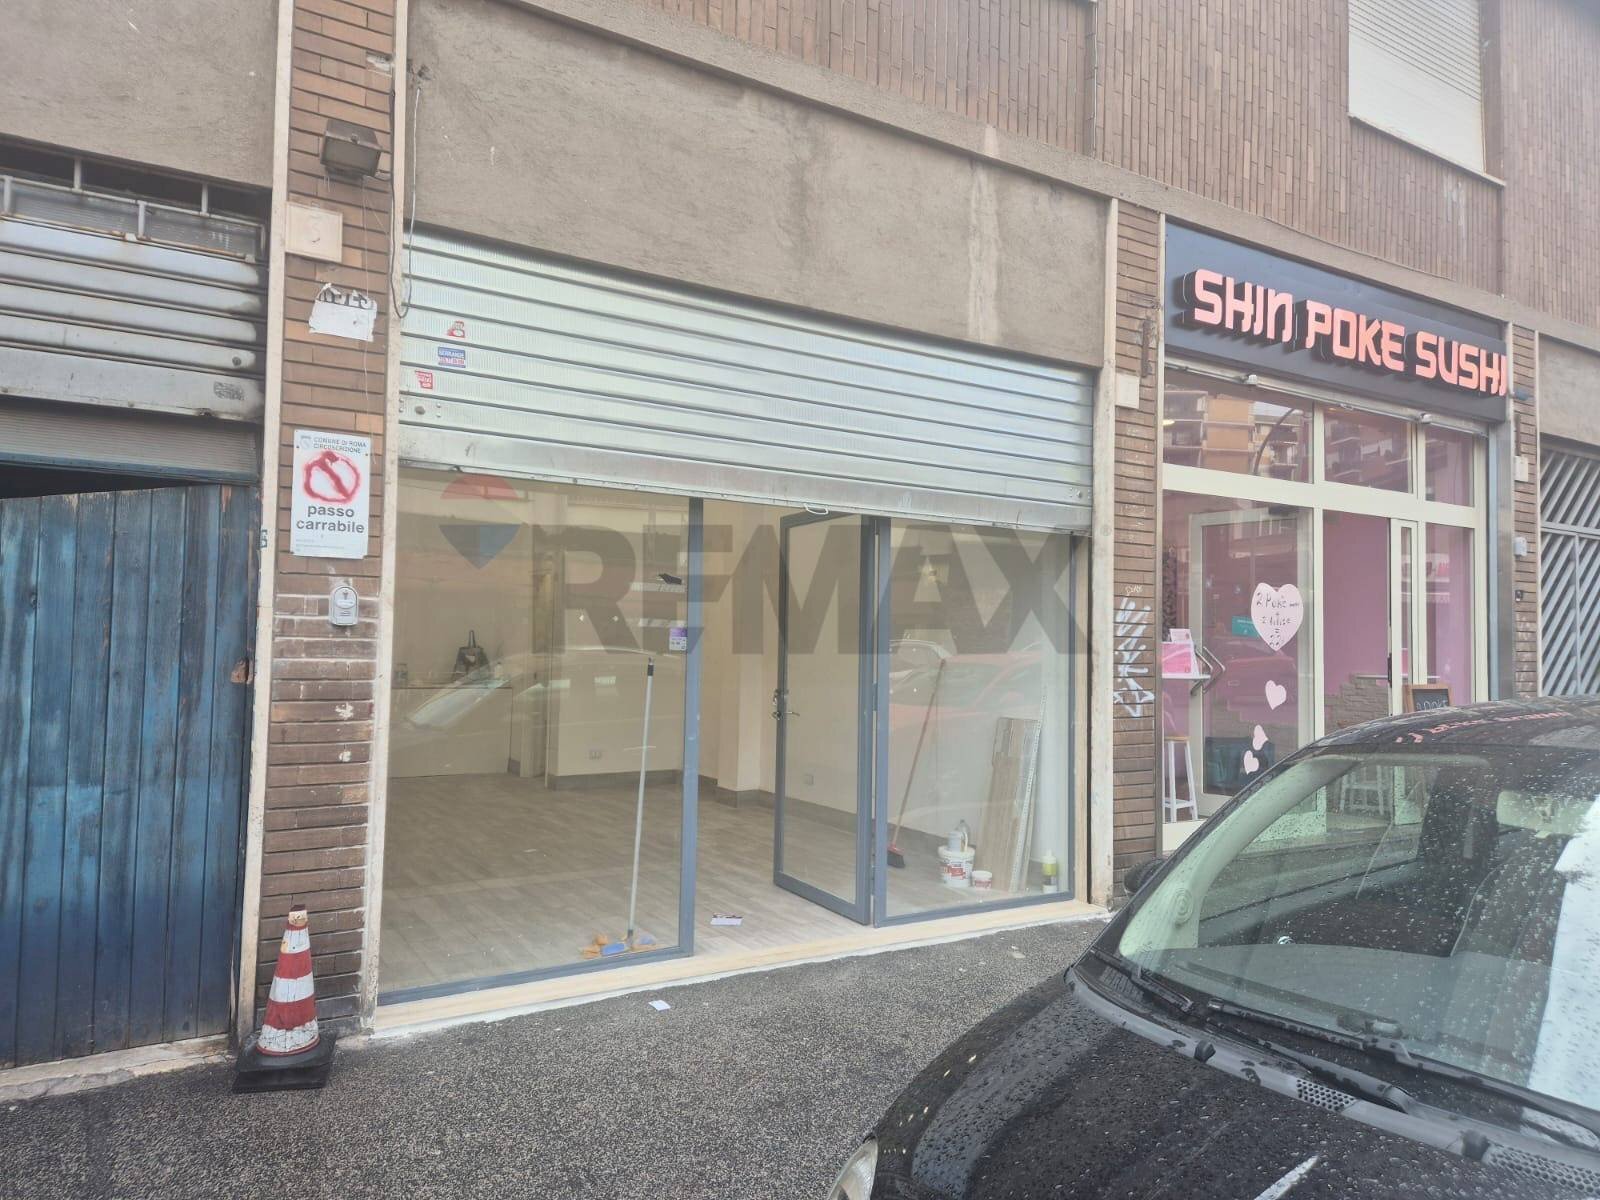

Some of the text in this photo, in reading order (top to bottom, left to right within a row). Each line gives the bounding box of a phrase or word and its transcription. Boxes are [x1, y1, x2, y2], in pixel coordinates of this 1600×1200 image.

[1305, 299, 1405, 372] POKE
[1415, 330, 1507, 397] SUSHI
[313, 437, 340, 446] COMUNE
[349, 440, 367, 448] ROMA
[307, 504, 355, 518] passo
[296, 519, 365, 534] carrabile
